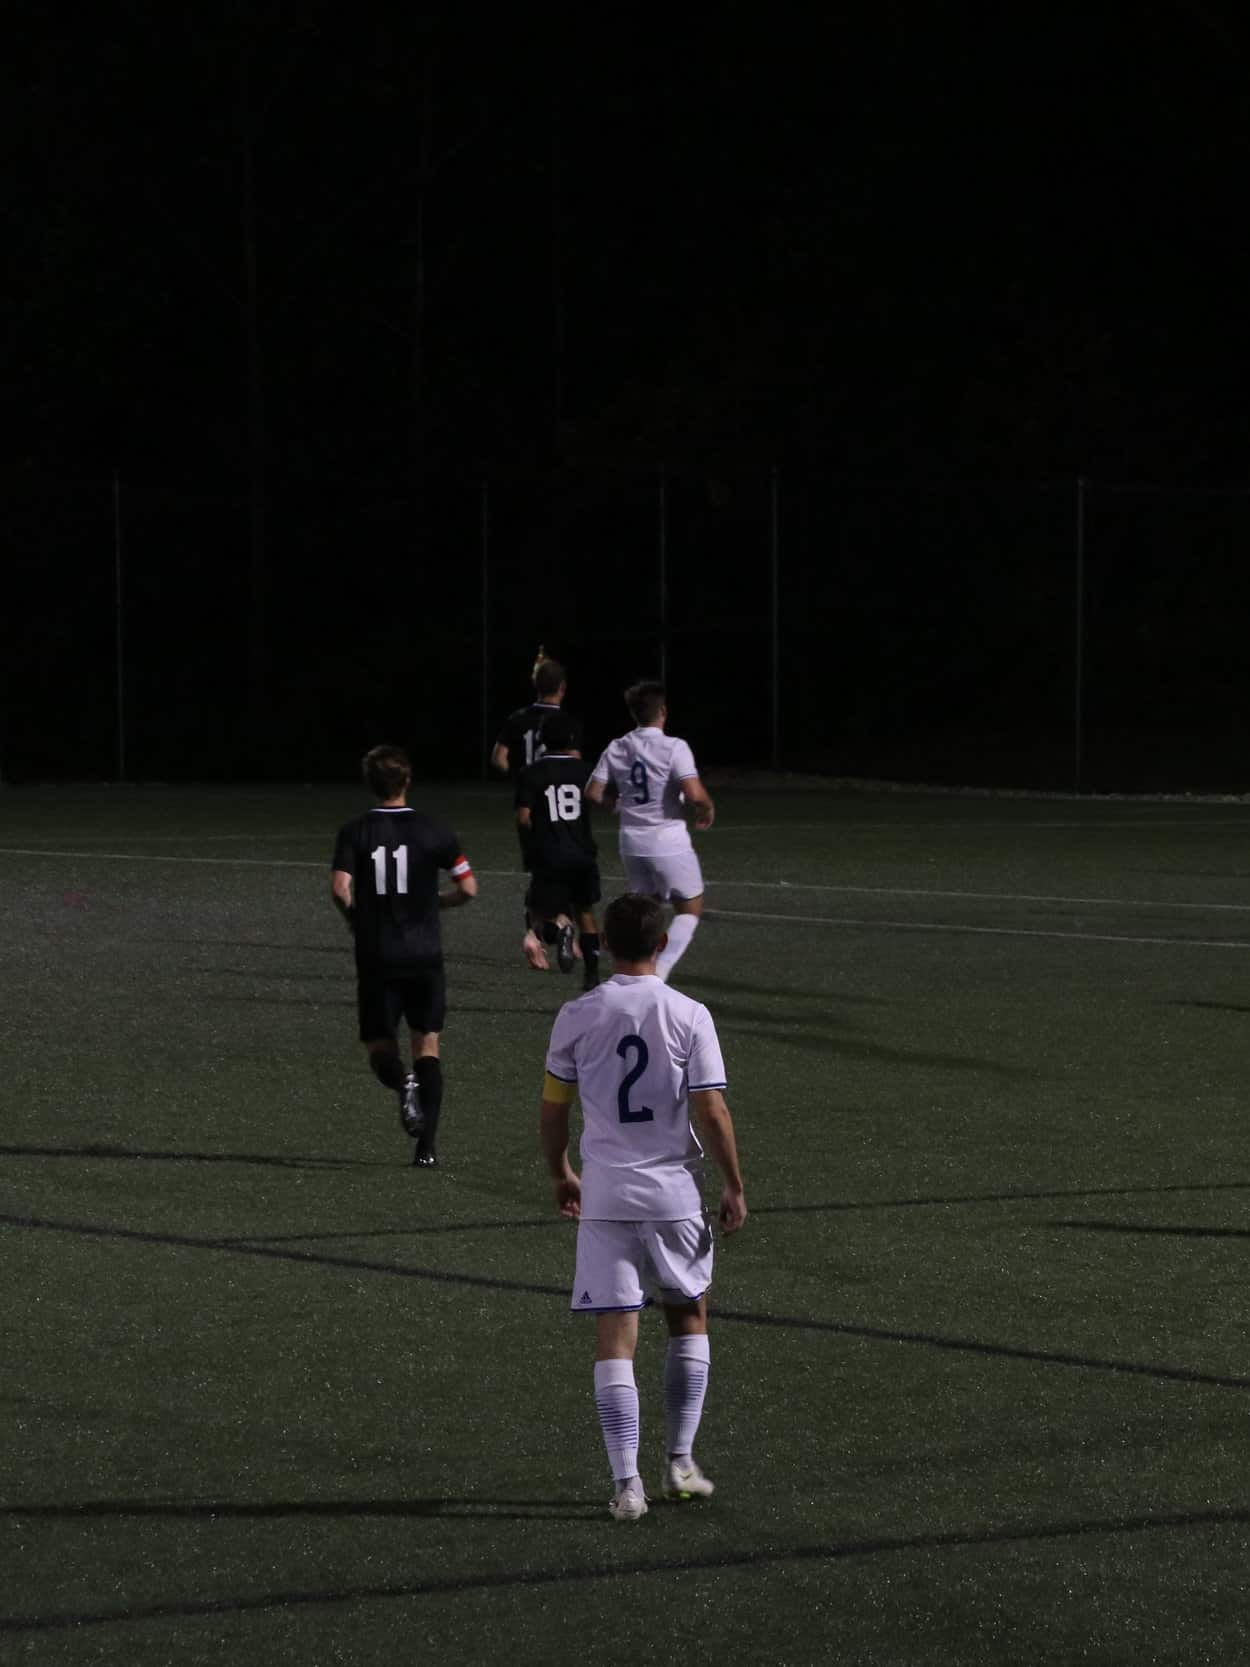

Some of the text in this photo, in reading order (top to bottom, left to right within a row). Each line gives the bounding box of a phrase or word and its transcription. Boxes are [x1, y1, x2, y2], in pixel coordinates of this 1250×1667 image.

[544, 783, 581, 822] 18
[630, 761, 649, 804] 9
[371, 844, 408, 895] 11
[616, 1034, 653, 1123] 2
